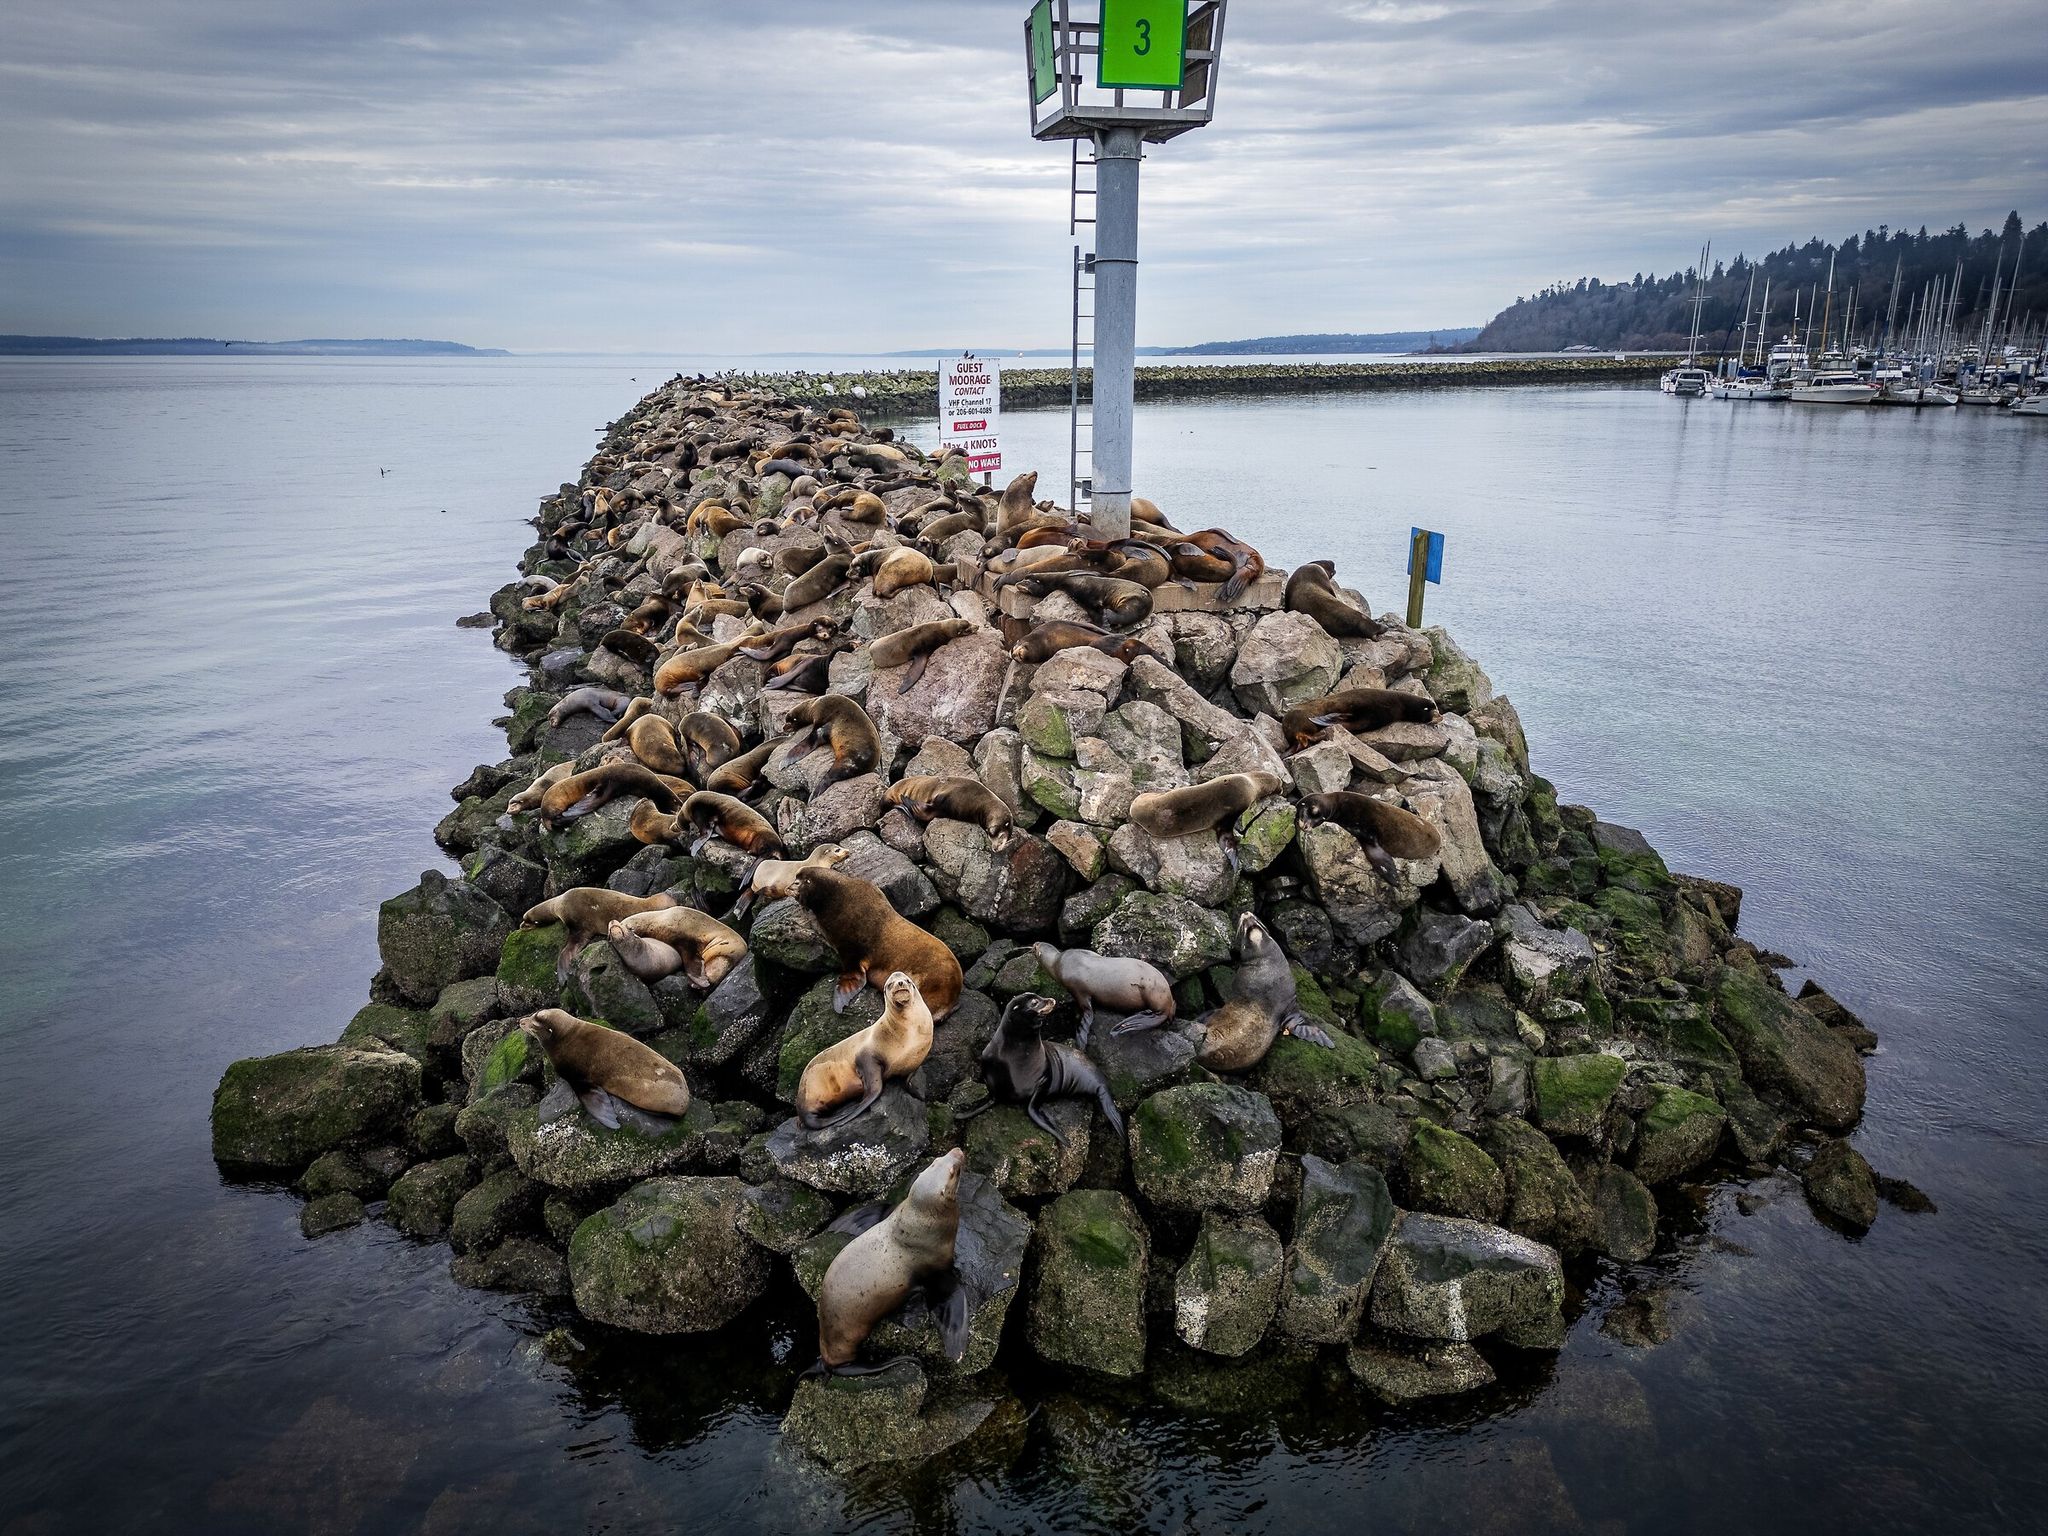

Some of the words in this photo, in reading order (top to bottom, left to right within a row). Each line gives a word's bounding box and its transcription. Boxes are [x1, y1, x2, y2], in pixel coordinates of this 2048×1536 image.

[1133, 18, 1151, 56] 3
[1039, 31, 1046, 67] 3
[957, 363, 983, 373] GUEST
[949, 375, 991, 386] MOORAGE
[954, 387, 985, 396] CONTACT
[961, 398, 984, 406] Channel
[985, 397, 992, 405] 17
[963, 441, 968, 450] 4
[970, 438, 997, 449] KNOTS
[968, 460, 979, 469] NO
[980, 457, 1000, 467] WAKE
